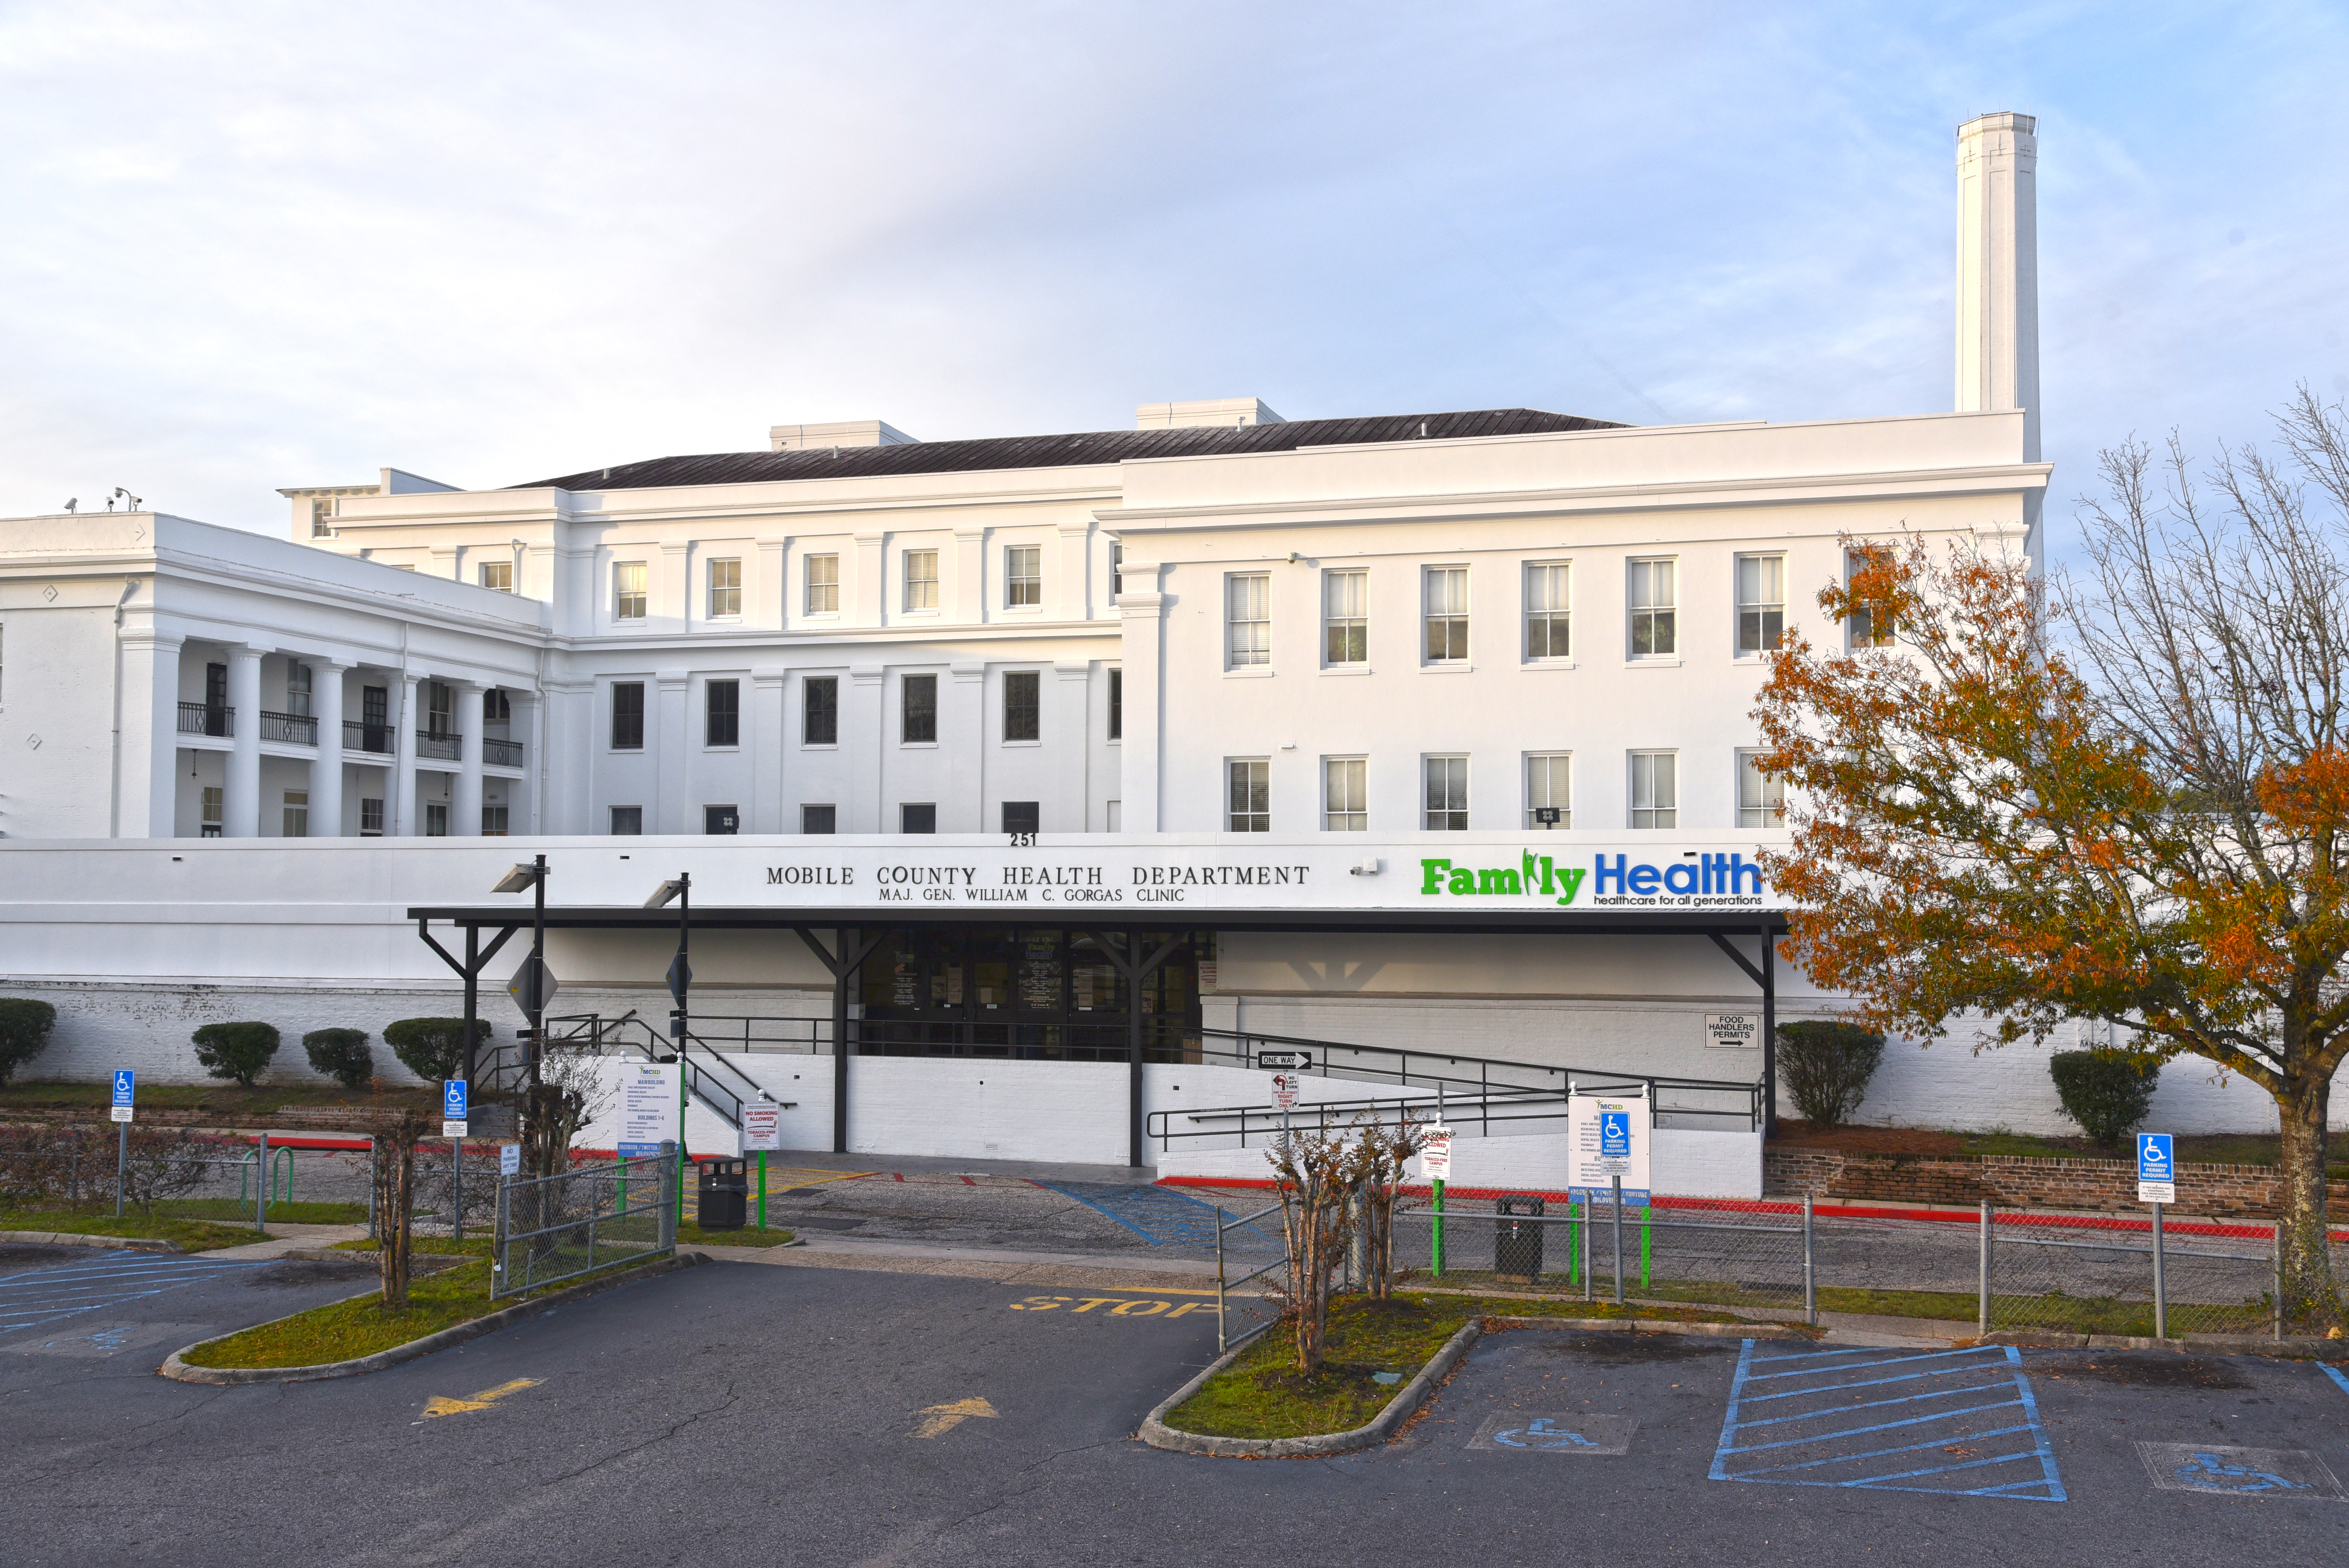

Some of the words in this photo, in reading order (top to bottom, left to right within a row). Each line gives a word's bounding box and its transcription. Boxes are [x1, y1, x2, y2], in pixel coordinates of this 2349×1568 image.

[1011, 833, 1035, 846] 251
[766, 867, 854, 885] MOBILE
[877, 866, 976, 885] COUNTY
[1003, 867, 1103, 885] HEALTH
[1132, 866, 1309, 885] DEPARTMENT
[1421, 848, 1585, 905] Family
[1595, 853, 1761, 894] Health
[879, 889, 913, 900] MAJ.
[923, 889, 955, 900] GEN.
[965, 889, 1027, 901] WILLIAM
[1042, 889, 1054, 901] C.
[1064, 889, 1122, 901] GORGAS
[1137, 889, 1184, 902] CLINIC
[1594, 896, 1656, 905] healthcare
[1659, 896, 1675, 905] for
[1677, 896, 1690, 905] all
[1694, 896, 1762, 907] generations
[1010, 1296, 1231, 1317] STOP
